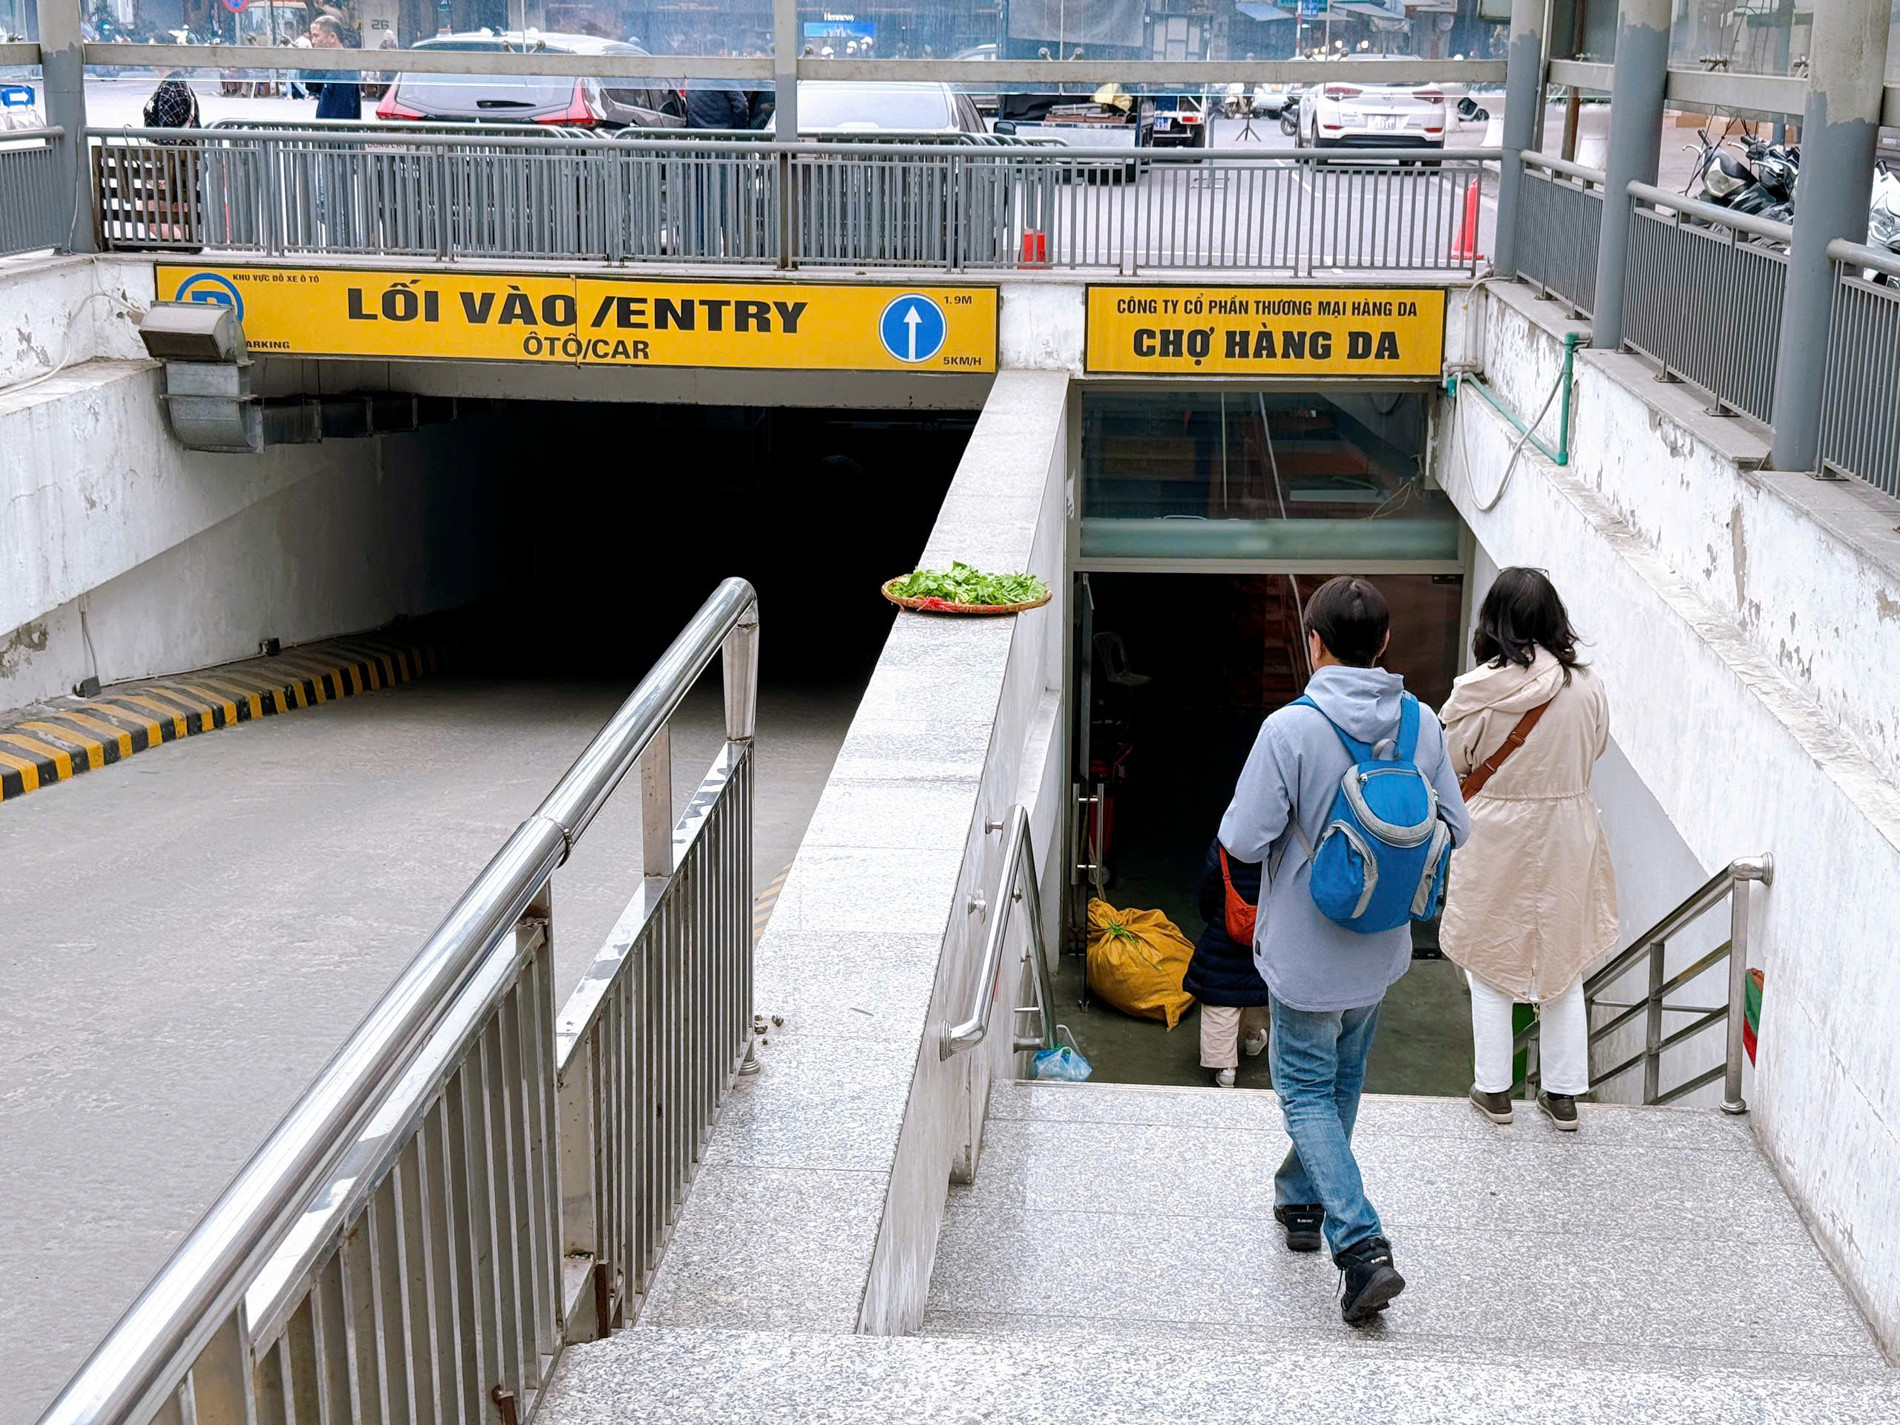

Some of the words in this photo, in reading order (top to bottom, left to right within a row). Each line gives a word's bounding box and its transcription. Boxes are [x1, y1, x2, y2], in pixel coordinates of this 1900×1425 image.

[824, 12, 855, 22] Hennessy
[232, 273, 250, 282] KHU
[252, 274, 270, 283] VỰC
[287, 275, 298, 283] XE
[943, 295, 972, 305] 1.9M
[1116, 295, 1158, 315] CÔNG
[1162, 299, 1179, 314] TY
[1183, 292, 1204, 315] CỔ
[1208, 296, 1249, 316] PHẦN
[1253, 298, 1313, 317] THƯƠNG
[1317, 300, 1347, 318] MẠI
[1351, 298, 1393, 317] HÀNG
[1396, 301, 1418, 317] DA
[347, 279, 440, 323] LỐI
[459, 283, 576, 327] VÀO
[590, 295, 809, 334] /ENTRY
[246, 340, 290, 349] ARKING
[522, 331, 650, 361] ÔTÔ/CAR
[1133, 326, 1216, 366] CHỢ
[1224, 322, 1333, 361] HÀNG
[1346, 330, 1401, 360] DA
[943, 356, 982, 366] 5KM/H
